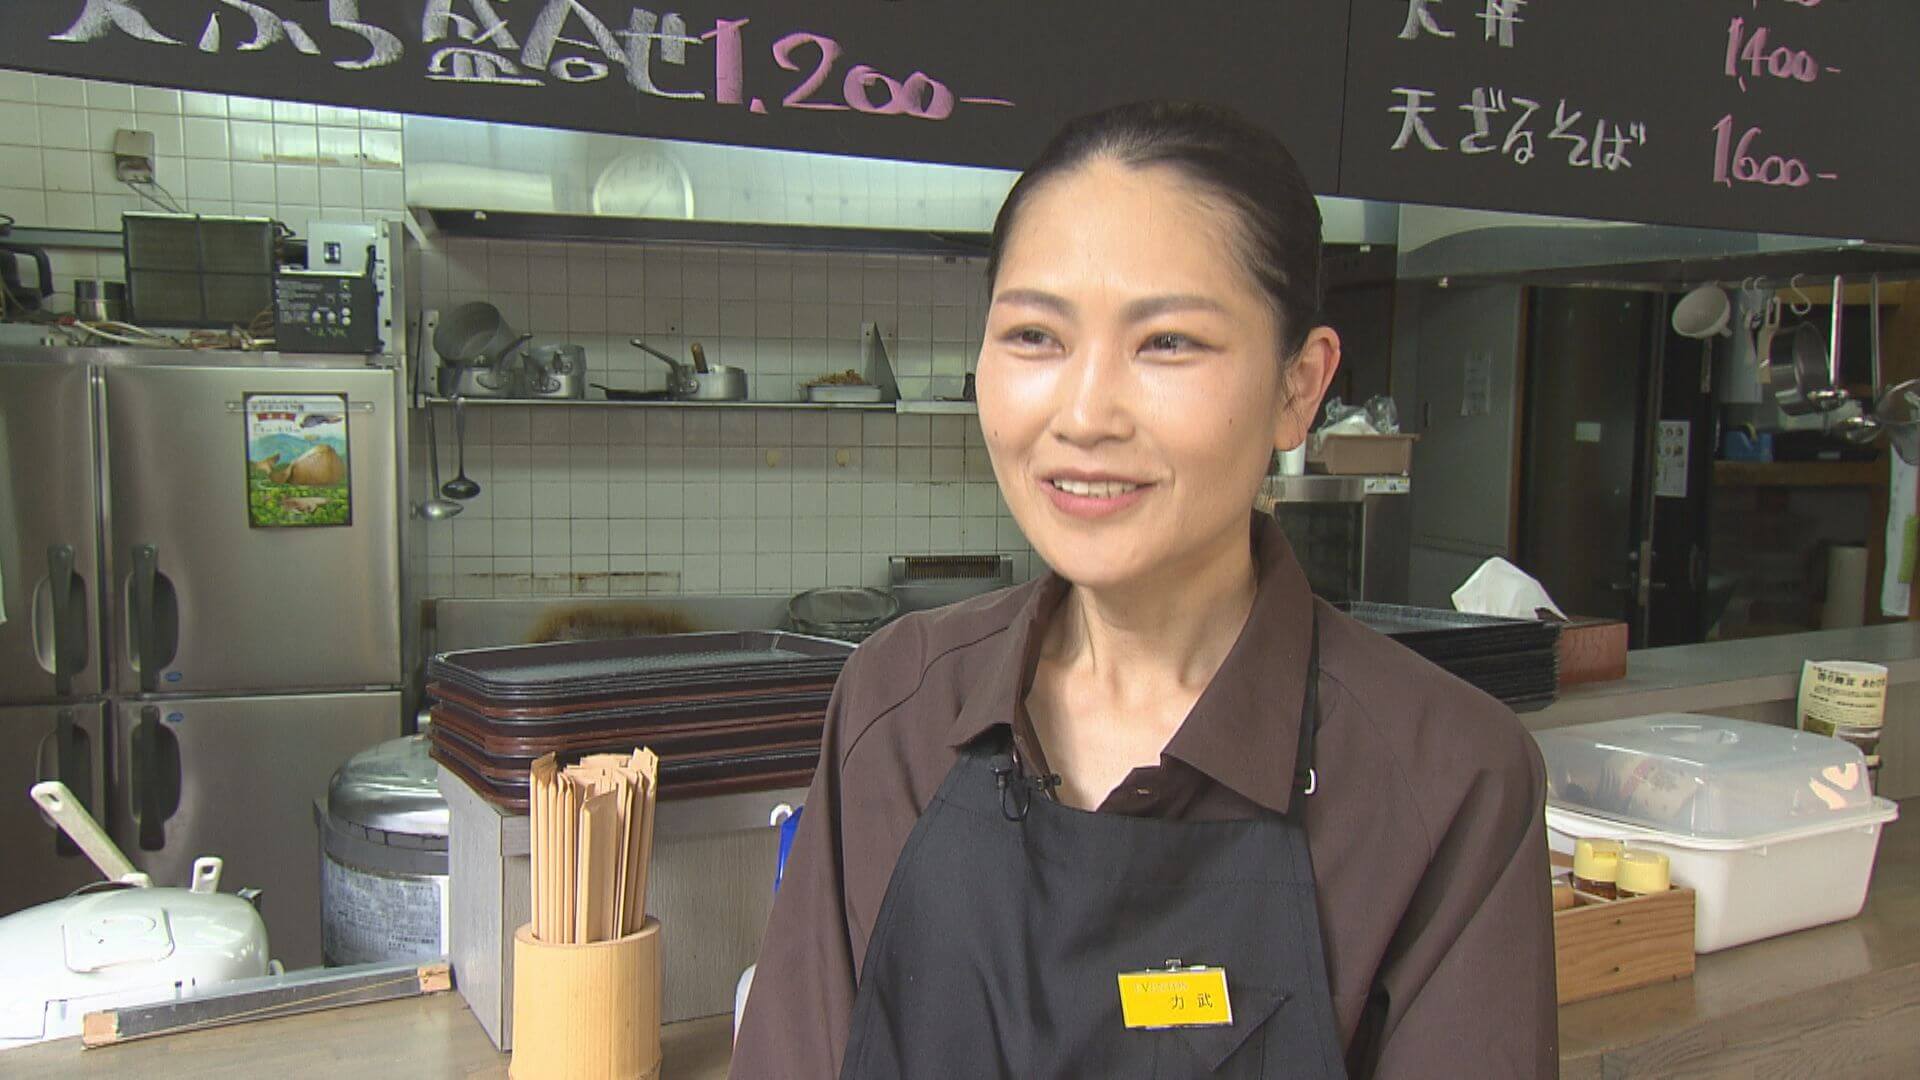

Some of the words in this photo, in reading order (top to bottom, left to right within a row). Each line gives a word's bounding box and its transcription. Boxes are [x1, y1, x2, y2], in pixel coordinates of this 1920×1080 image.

[1387, 87, 1647, 170] 天ざるそば
